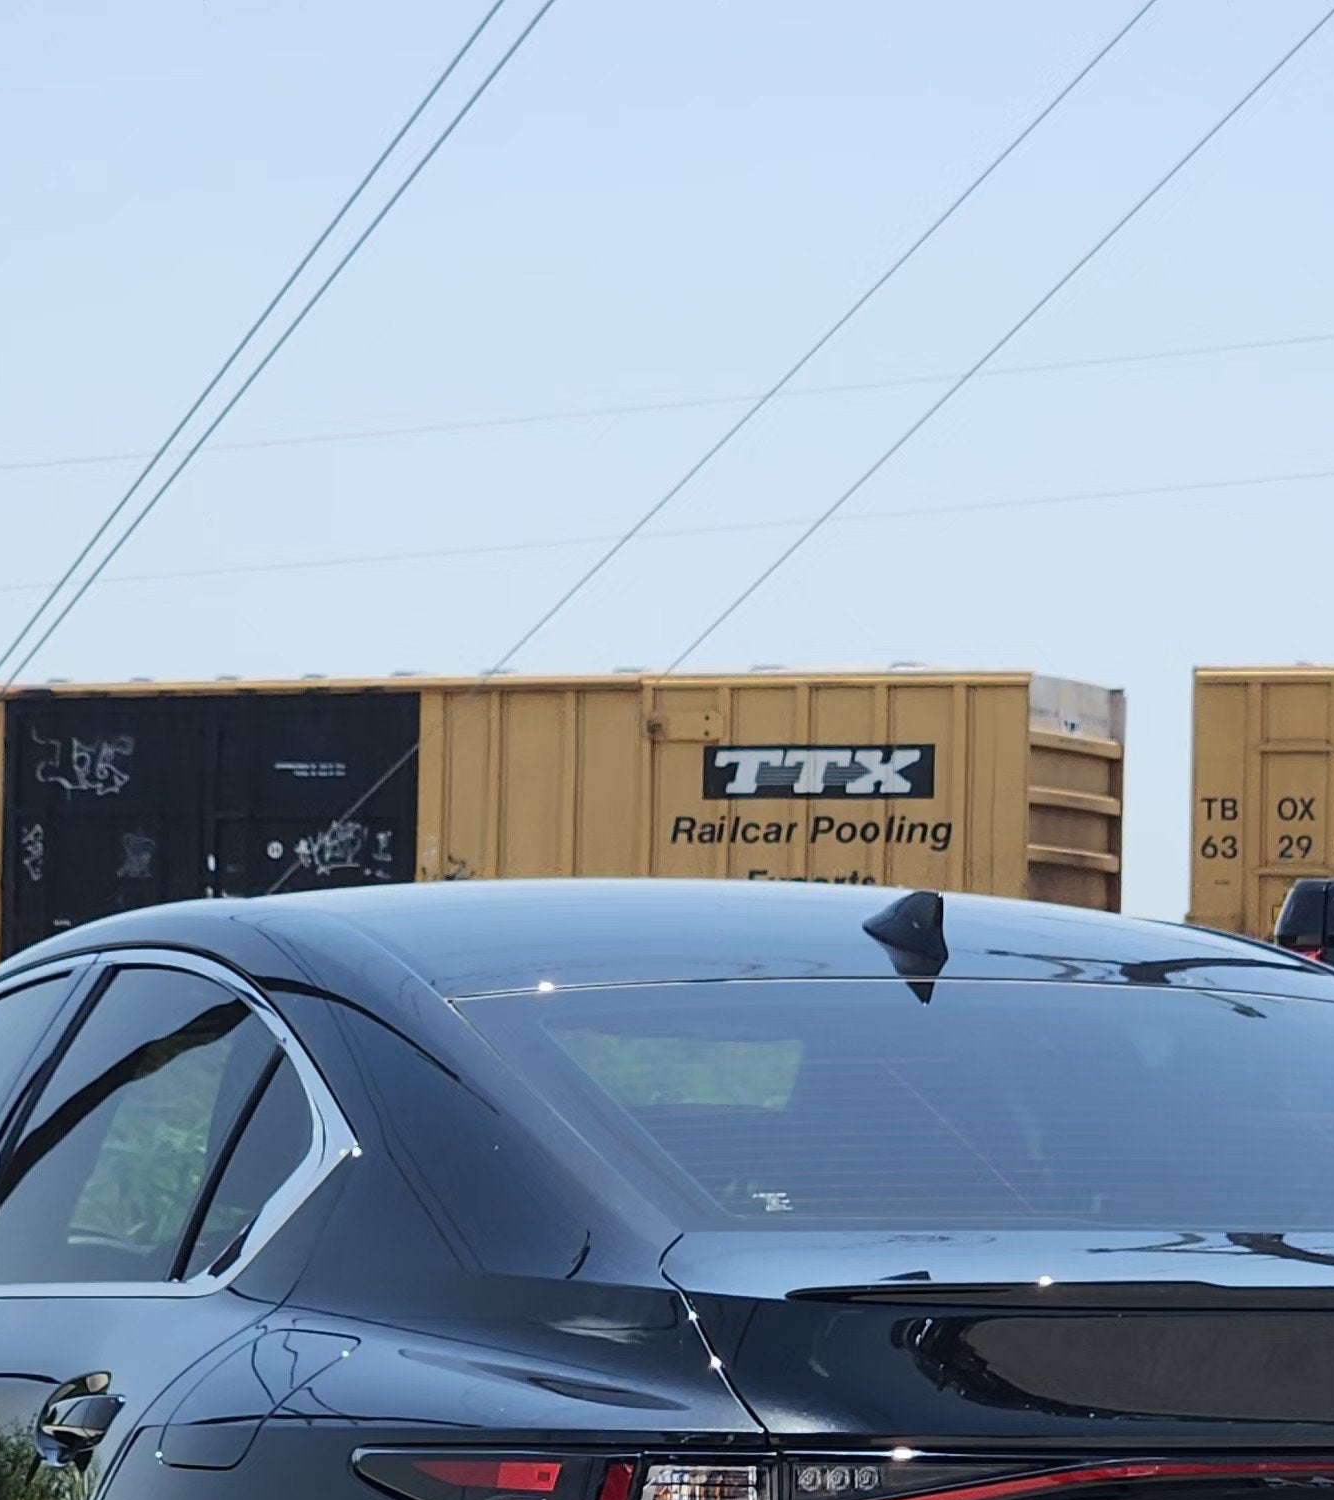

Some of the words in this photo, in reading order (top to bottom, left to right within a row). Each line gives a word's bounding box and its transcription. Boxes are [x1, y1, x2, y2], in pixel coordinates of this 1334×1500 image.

[714, 748, 921, 794] TTX
[670, 815, 798, 844] Railcar
[810, 815, 953, 852] Pooling
